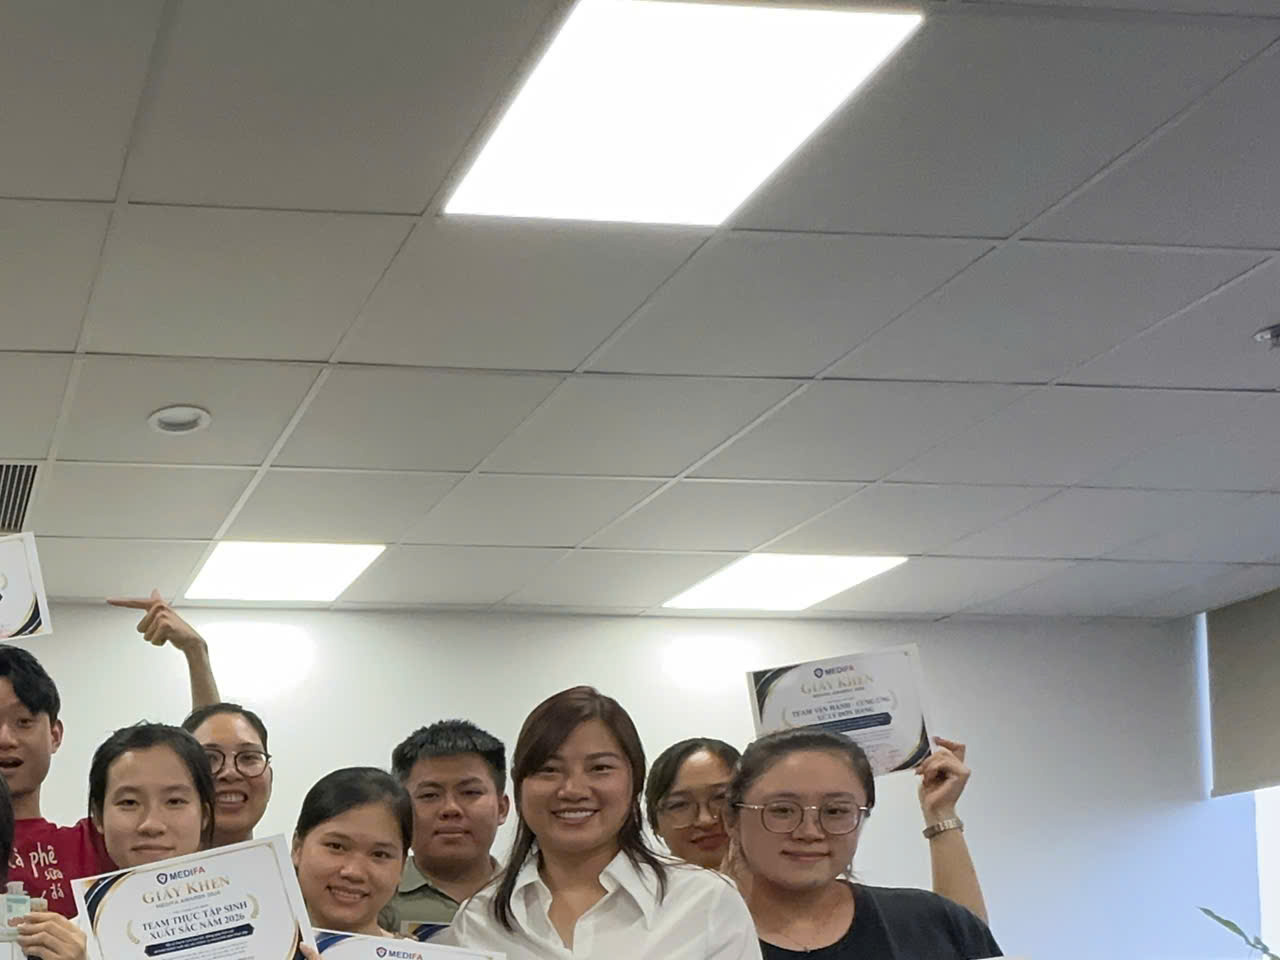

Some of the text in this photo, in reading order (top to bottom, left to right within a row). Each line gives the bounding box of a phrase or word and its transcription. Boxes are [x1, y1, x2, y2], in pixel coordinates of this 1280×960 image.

[825, 664, 855, 675] MEDIFA
[29, 842, 58, 878] phê
[169, 866, 206, 881] MEDIFA
[187, 875, 230, 895] KHEN
[142, 918, 170, 931] TEAM
[224, 901, 248, 913] SINH
[224, 913, 246, 924] 2026
[388, 950, 424, 960] MEDIFA
